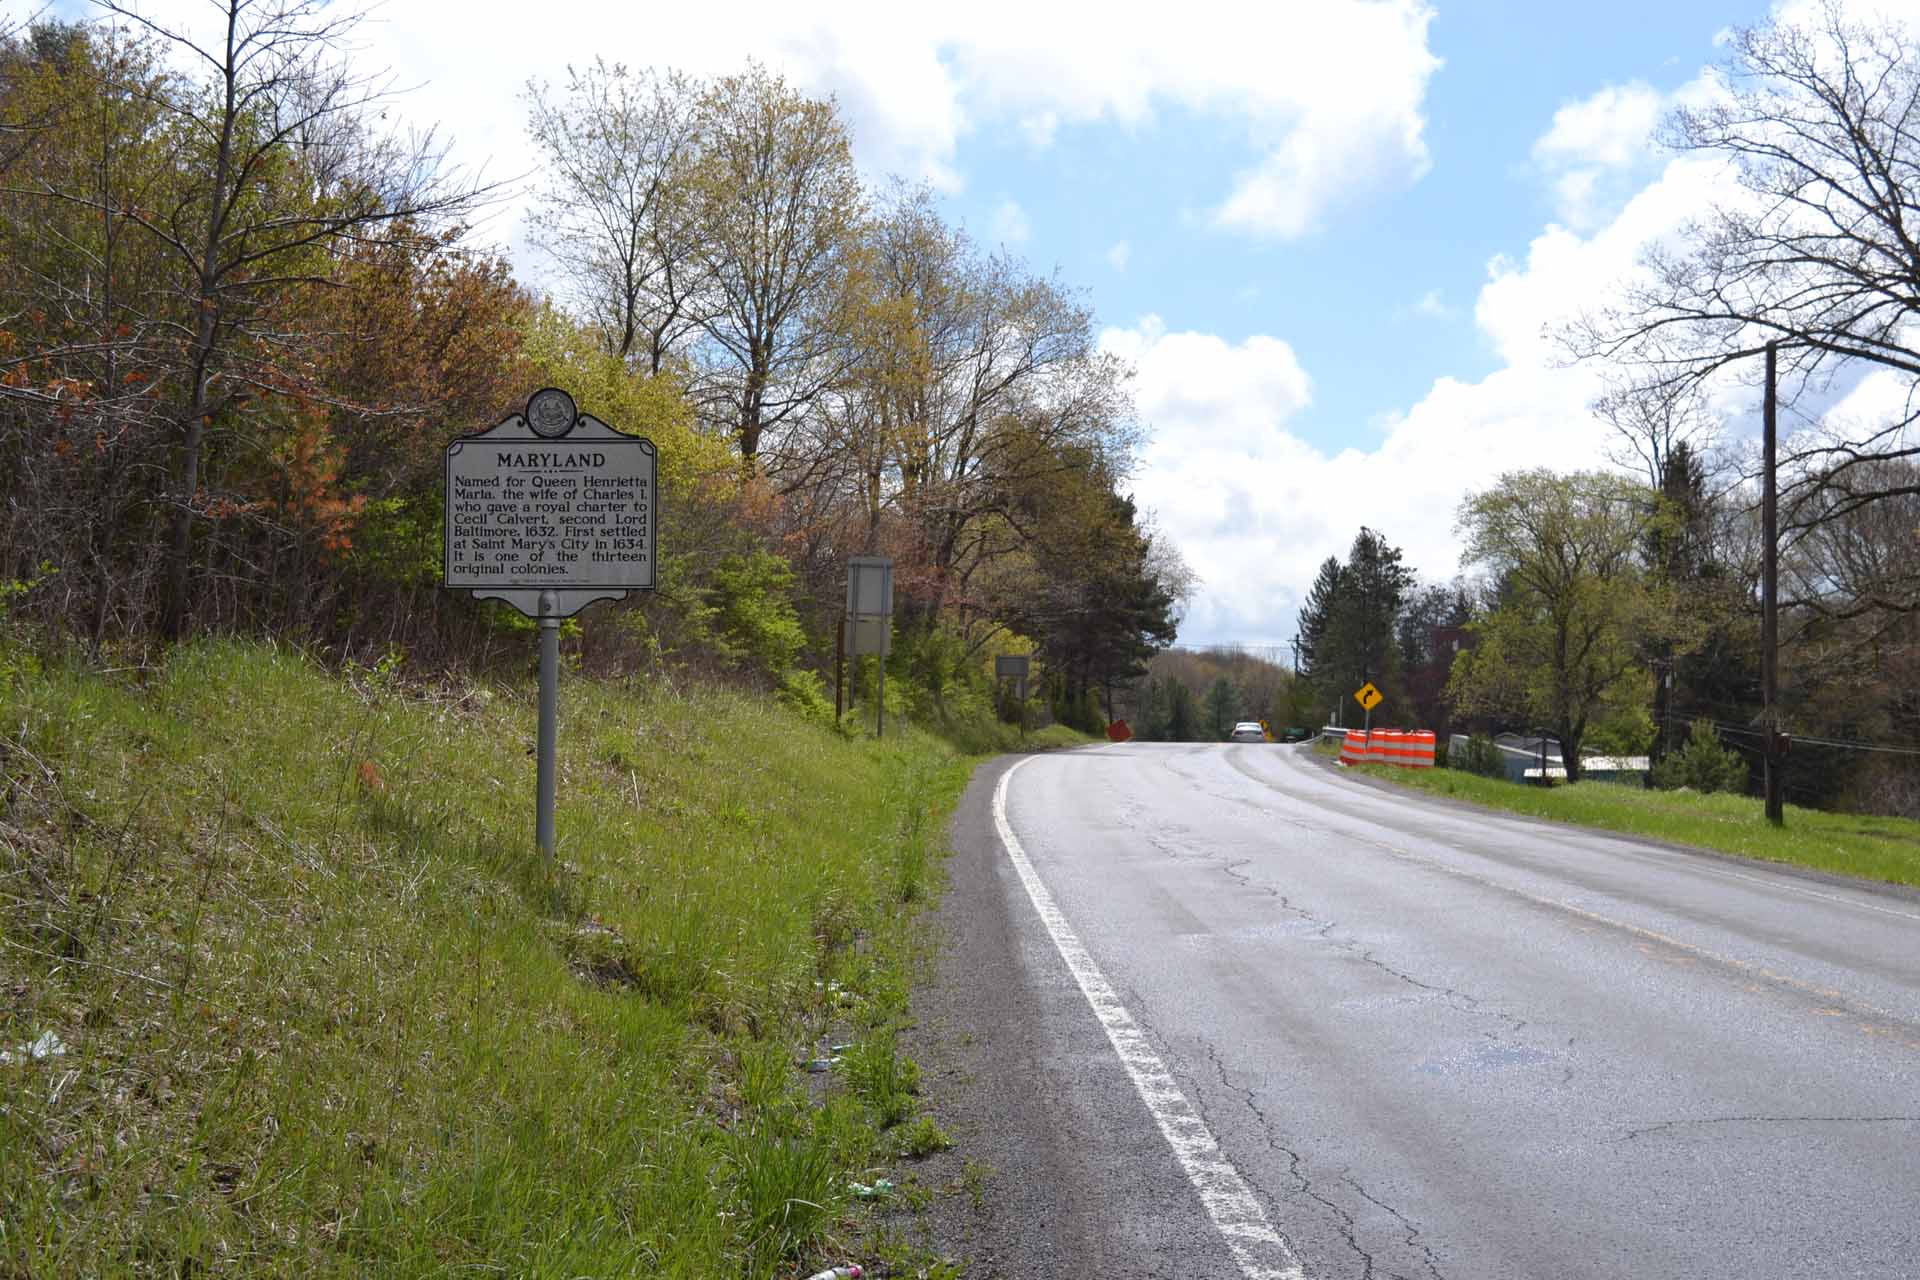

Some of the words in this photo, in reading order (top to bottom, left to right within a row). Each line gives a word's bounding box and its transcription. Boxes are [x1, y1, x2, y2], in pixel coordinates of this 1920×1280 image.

[497, 454, 606, 467] MARYLAND
[455, 476, 499, 487] Named
[506, 476, 526, 487] for
[532, 476, 576, 488] Queen
[584, 477, 647, 487] Henrietta
[503, 489, 523, 499] the
[529, 489, 557, 499] wife
[564, 489, 577, 499] of
[583, 489, 634, 499] Charles
[455, 502, 481, 512] who
[487, 504, 517, 515] gave
[536, 502, 570, 515] royal
[576, 502, 627, 512] charter
[634, 503, 647, 512] to
[454, 514, 487, 525] Cecil
[559, 514, 606, 525] second
[616, 514, 647, 525] Lord
[565, 527, 594, 537] First
[600, 526, 646, 537] settled
[454, 540, 467, 549] at
[472, 539, 505, 549] Saint
[512, 539, 555, 551] Mary's
[561, 539, 589, 552] City
[595, 539, 607, 549] in
[454, 551, 463, 561] It
[474, 551, 484, 561] is
[496, 553, 519, 562] one
[530, 551, 544, 562] of
[557, 552, 578, 561] the
[592, 552, 647, 561] thirteen
[454, 564, 504, 576] original
